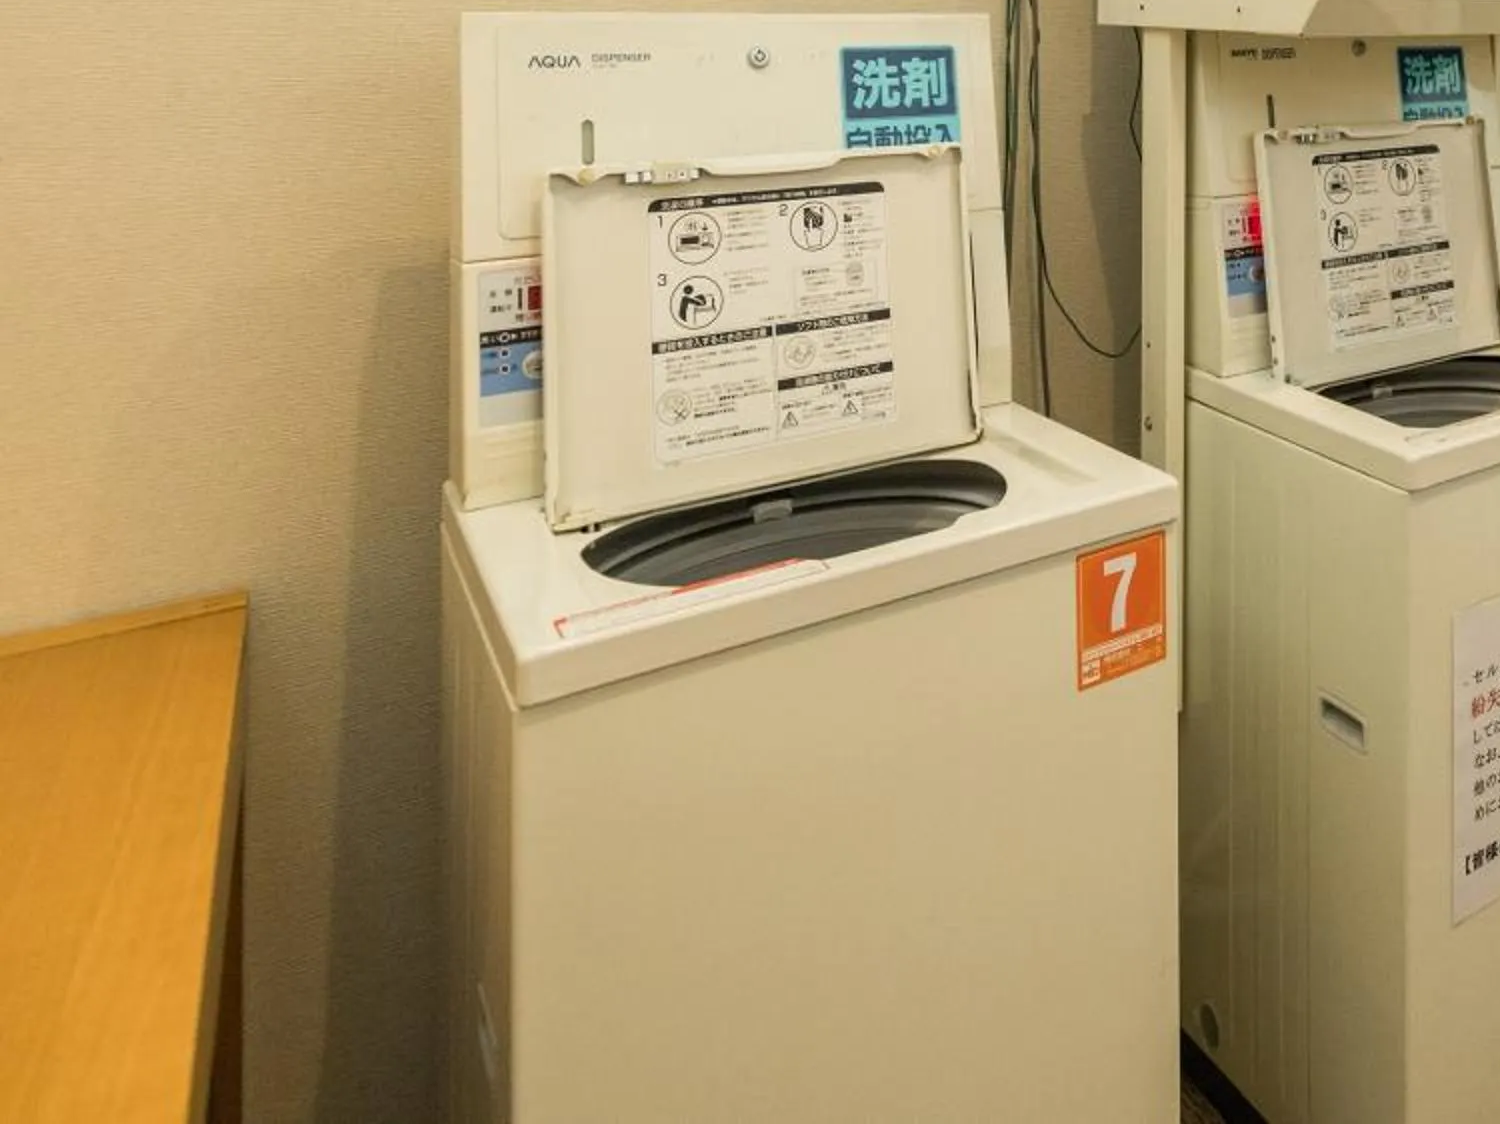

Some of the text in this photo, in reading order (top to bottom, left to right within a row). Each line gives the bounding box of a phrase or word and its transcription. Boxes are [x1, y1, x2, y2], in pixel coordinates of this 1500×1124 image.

[528, 55, 581, 69] AQUA
[1404, 54, 1461, 95] 洗剤
[852, 57, 948, 109] 洗剤
[657, 274, 667, 287] 3
[1103, 551, 1137, 633] 7
